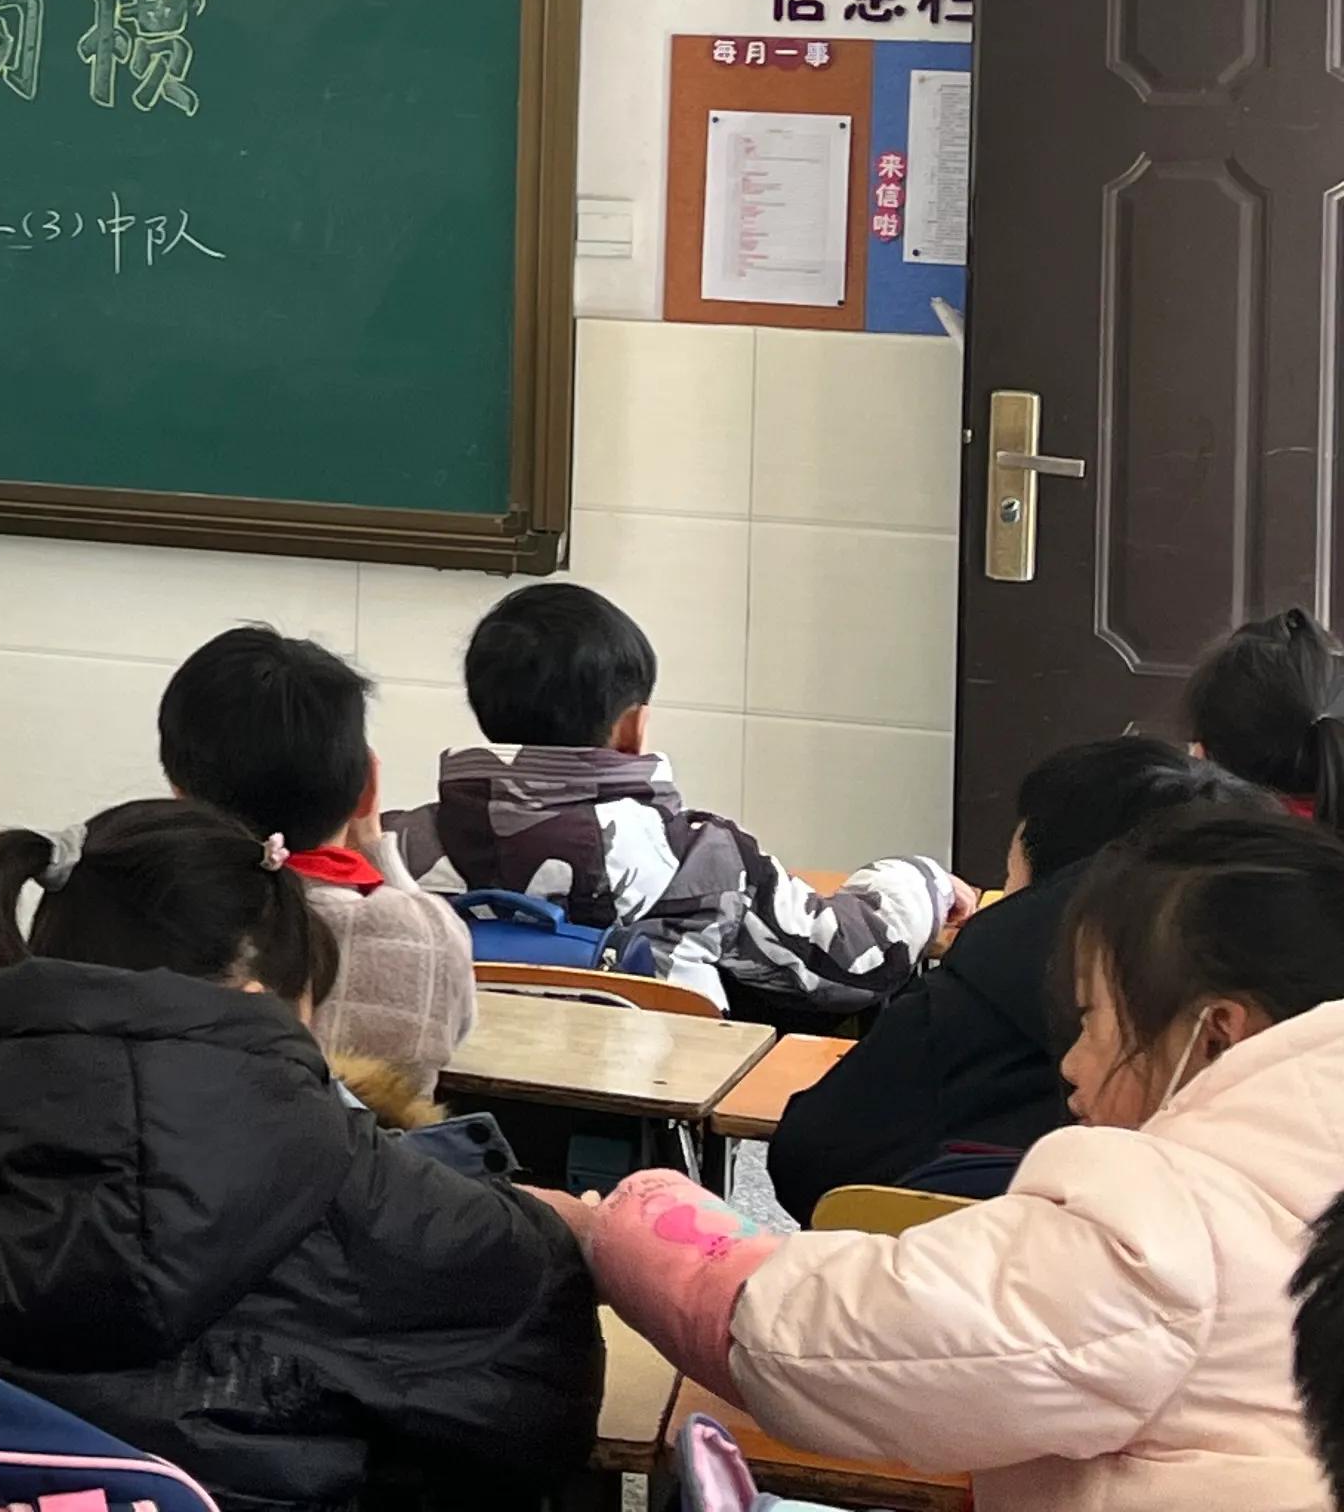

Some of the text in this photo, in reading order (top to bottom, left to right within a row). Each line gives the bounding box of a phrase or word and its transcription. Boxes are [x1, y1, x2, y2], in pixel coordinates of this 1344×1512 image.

[713, 39, 830, 68] 每月一事
[872, 154, 906, 237] 来信啦
